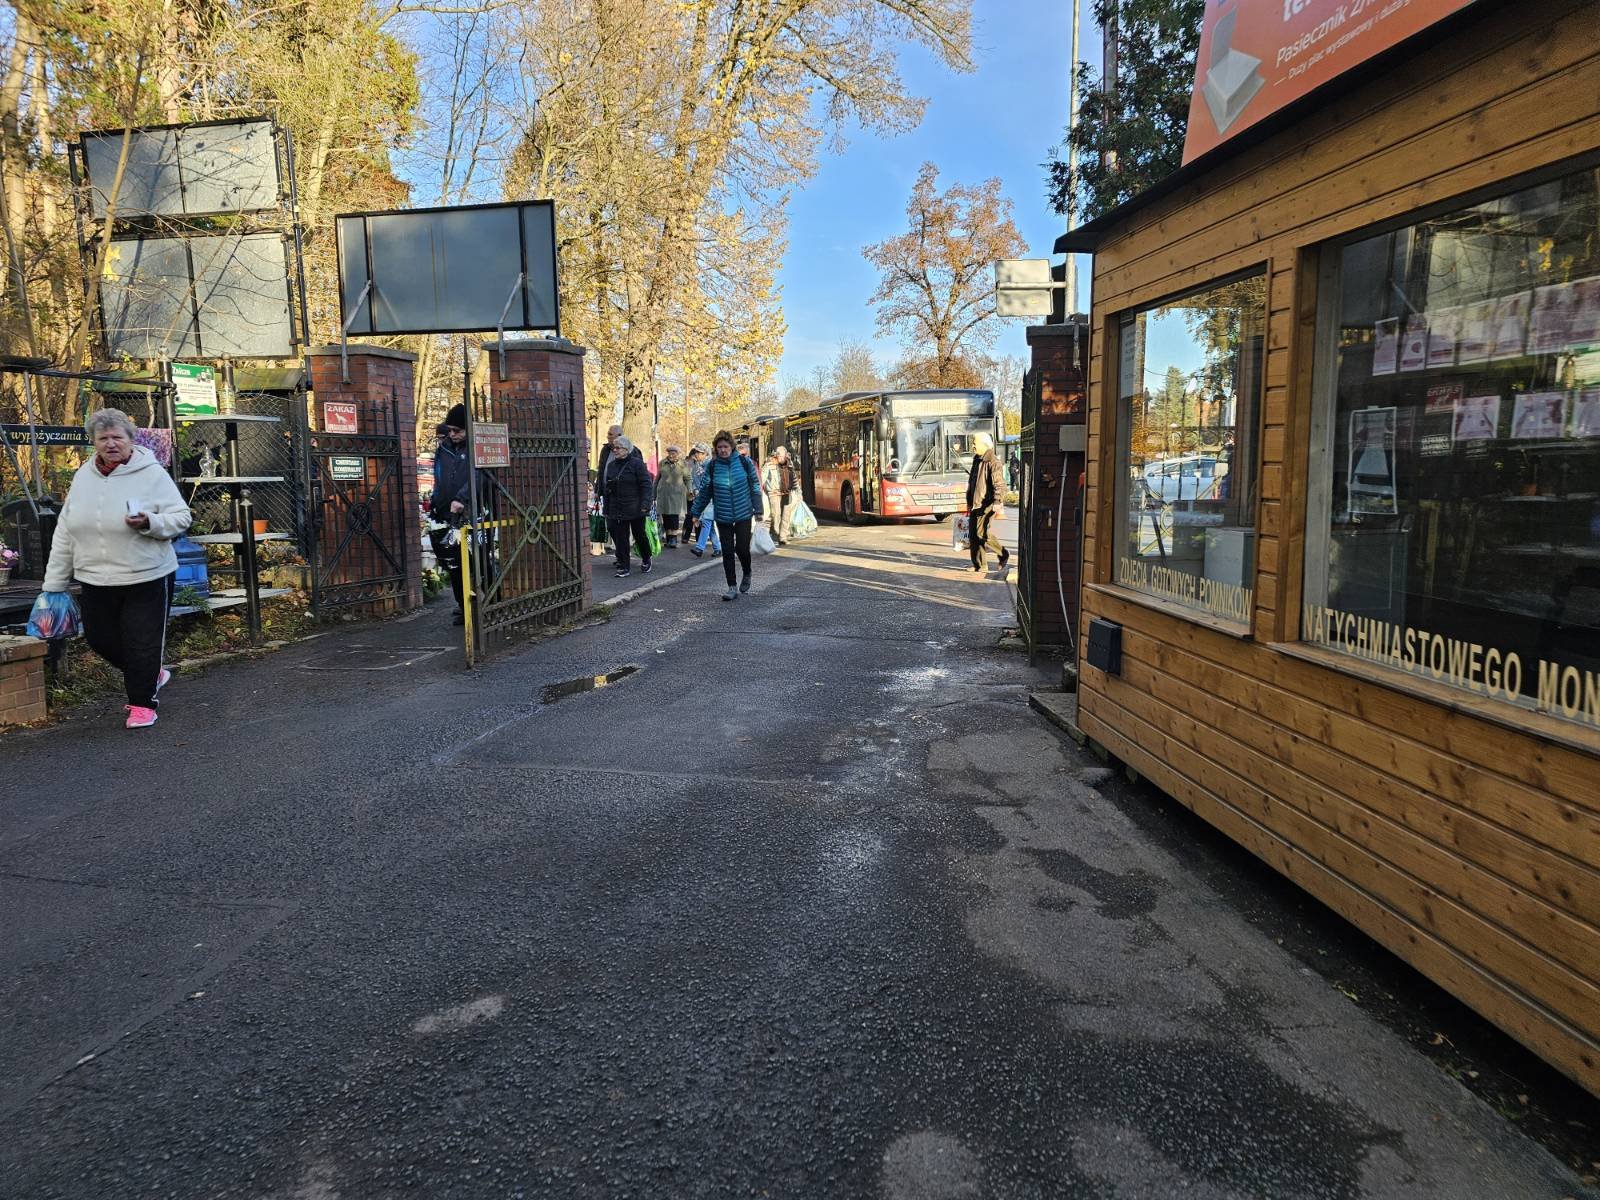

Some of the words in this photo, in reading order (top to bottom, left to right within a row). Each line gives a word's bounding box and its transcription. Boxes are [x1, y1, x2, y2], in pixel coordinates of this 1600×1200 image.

[1275, 5, 1347, 68] Pasiecznik
[327, 405, 355, 413] ZAKAZ
[11, 429, 81, 443] wypożyczania
[1151, 565, 1196, 604] GOTOWYCH
[1302, 604, 1522, 701] NATYCHMIASTOWEGO
